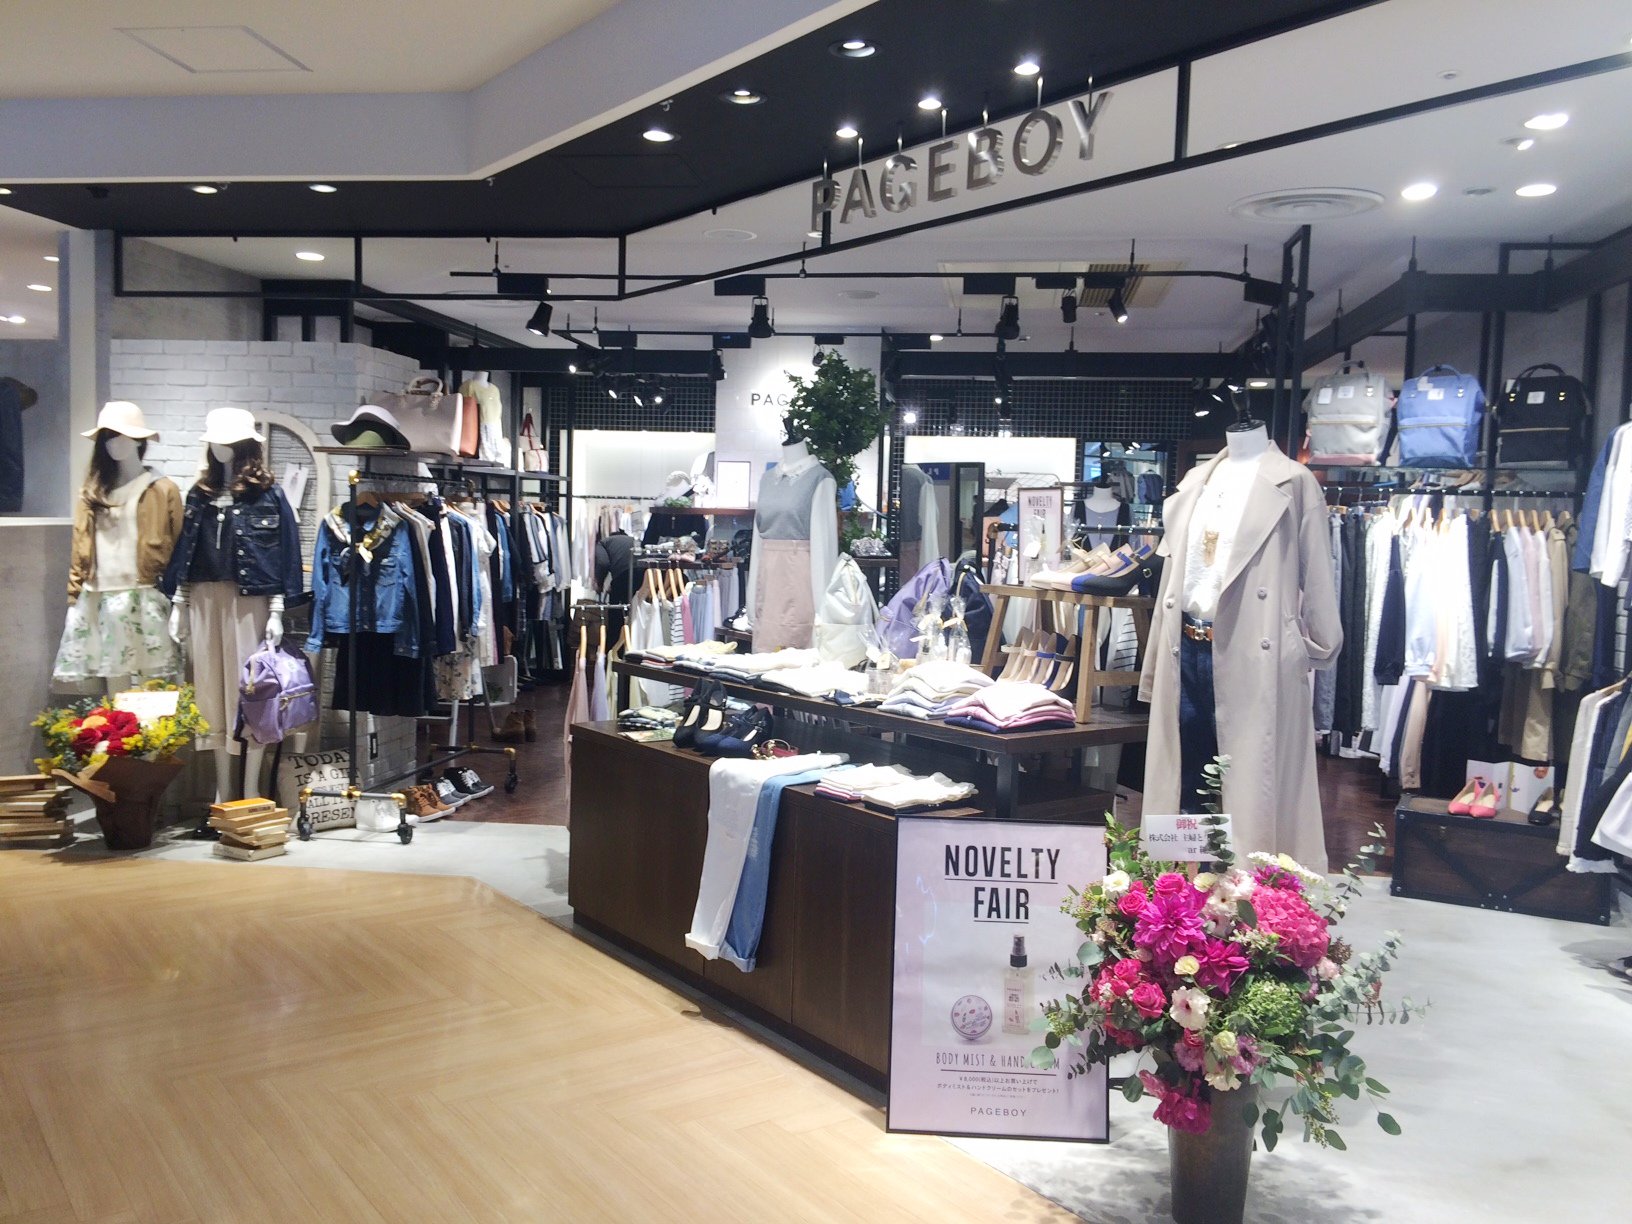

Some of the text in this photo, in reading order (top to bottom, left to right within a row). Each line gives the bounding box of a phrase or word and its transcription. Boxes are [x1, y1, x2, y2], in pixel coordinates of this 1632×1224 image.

[811, 91, 1113, 233] PAGEBOY
[751, 393, 788, 406] PAG
[295, 773, 313, 787] IS
[945, 844, 1060, 880] NOVELTY
[974, 886, 1029, 920] FAIR
[936, 1052, 959, 1065] BODY
[963, 1054, 986, 1068] MIST
[990, 1054, 996, 1067] &
[970, 1107, 1027, 1117] PAGEBOY
